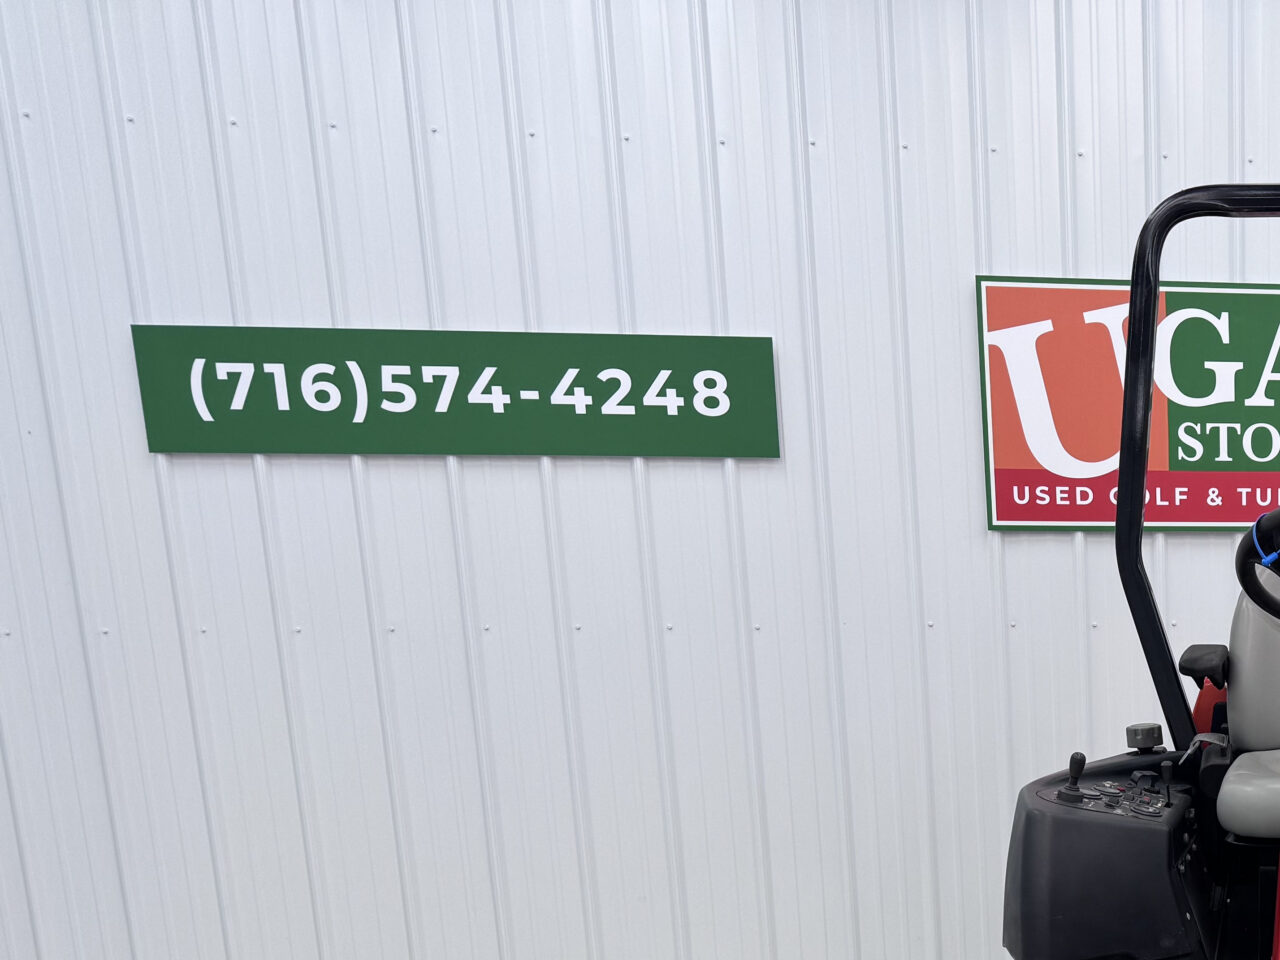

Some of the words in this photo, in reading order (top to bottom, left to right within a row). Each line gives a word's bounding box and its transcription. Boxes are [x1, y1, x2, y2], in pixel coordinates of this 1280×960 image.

[189, 357, 732, 423] (716)574-4248
[1012, 485, 1094, 506] USED
[1109, 486, 1189, 506] LF
[1206, 487, 1223, 507] &
